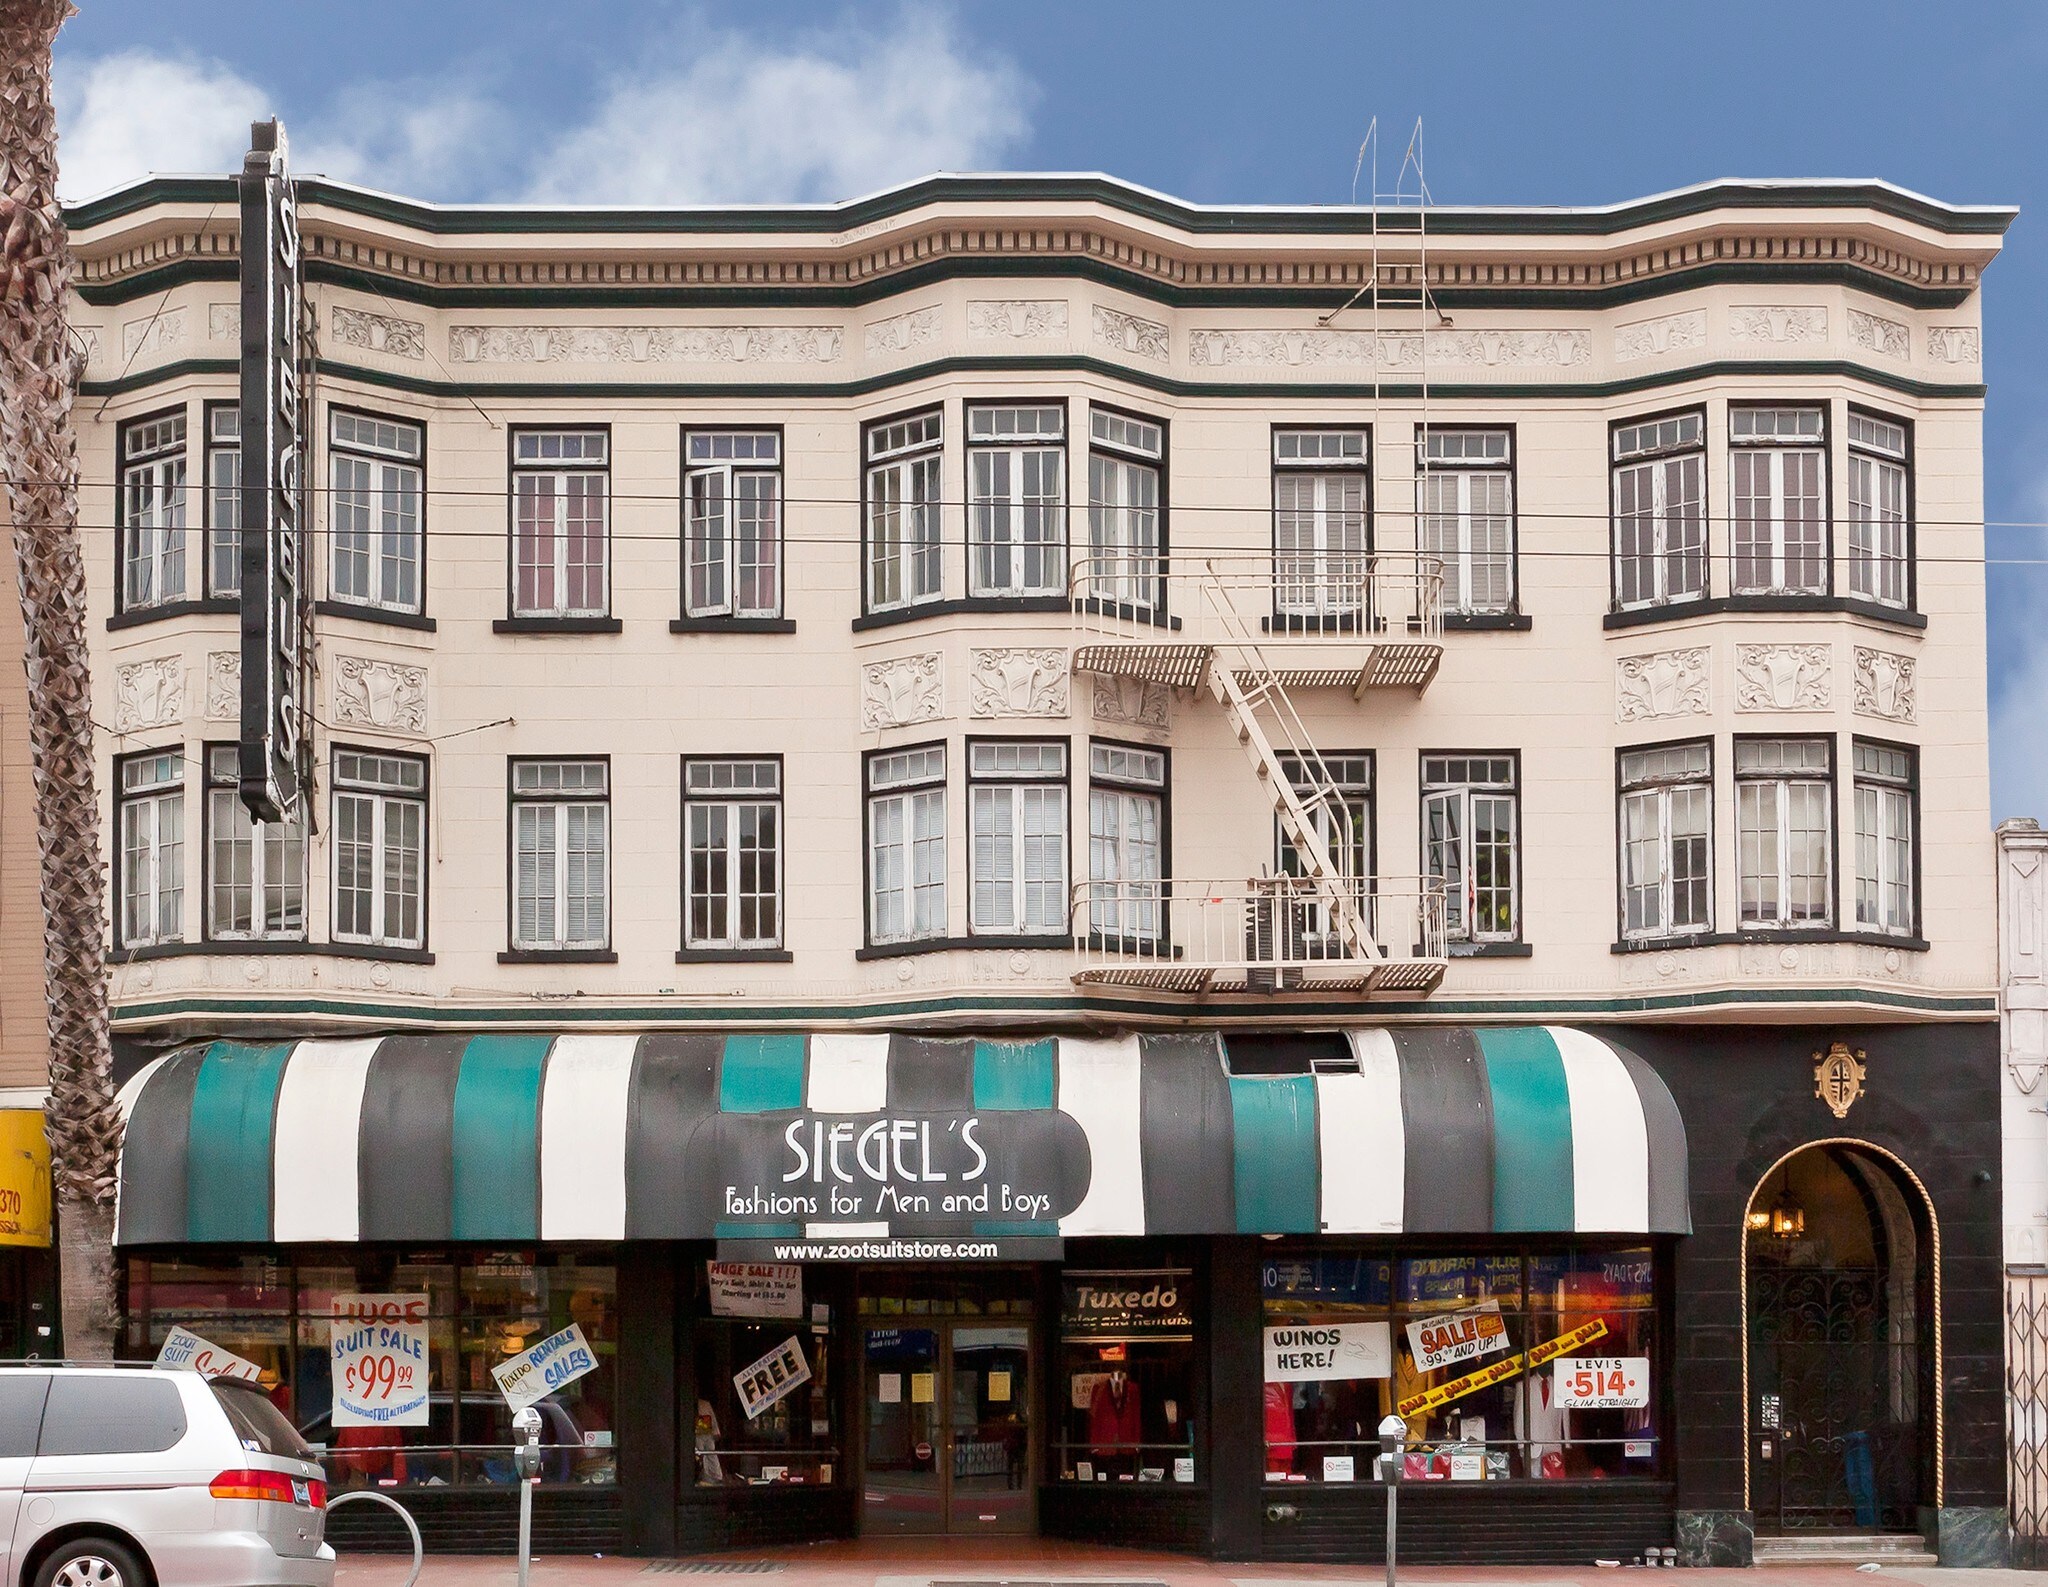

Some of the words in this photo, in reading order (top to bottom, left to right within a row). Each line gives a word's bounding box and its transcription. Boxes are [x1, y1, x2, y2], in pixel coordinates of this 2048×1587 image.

[277, 195, 297, 764] SIEGEL'S
[782, 1118, 988, 1183] SIEGEL'S
[725, 1185, 818, 1215] Fashions
[830, 1185, 863, 1215] for
[875, 1185, 930, 1214] Men
[941, 1183, 989, 1214] and
[1001, 1184, 1051, 1220] Boys
[774, 1241, 998, 1259] www.zootsuitstore.com
[710, 1263, 744, 1275] HUGE
[747, 1265, 774, 1277] SALE
[1077, 1285, 1177, 1309] Tuxedo
[333, 1301, 426, 1326] HUGE
[170, 1334, 199, 1350] ZOOT
[335, 1327, 376, 1359] SUIT
[380, 1327, 423, 1360] SALE
[528, 1329, 576, 1368] RENTALS
[1273, 1328, 1341, 1347] WINO'S
[1420, 1318, 1477, 1354] SALE
[1454, 1341, 1475, 1359] AND
[1478, 1335, 1498, 1352] UP!
[164, 1347, 193, 1363] SUIT
[1277, 1349, 1335, 1370] HERE!
[1576, 1359, 1622, 1370] LEVI'S
[498, 1363, 532, 1393] TUXEDO
[544, 1347, 592, 1390] SALES
[742, 1350, 800, 1405] FREE
[1574, 1371, 1626, 1397] 514
[1564, 1398, 1640, 1408] SLIM-STRAIGHT
